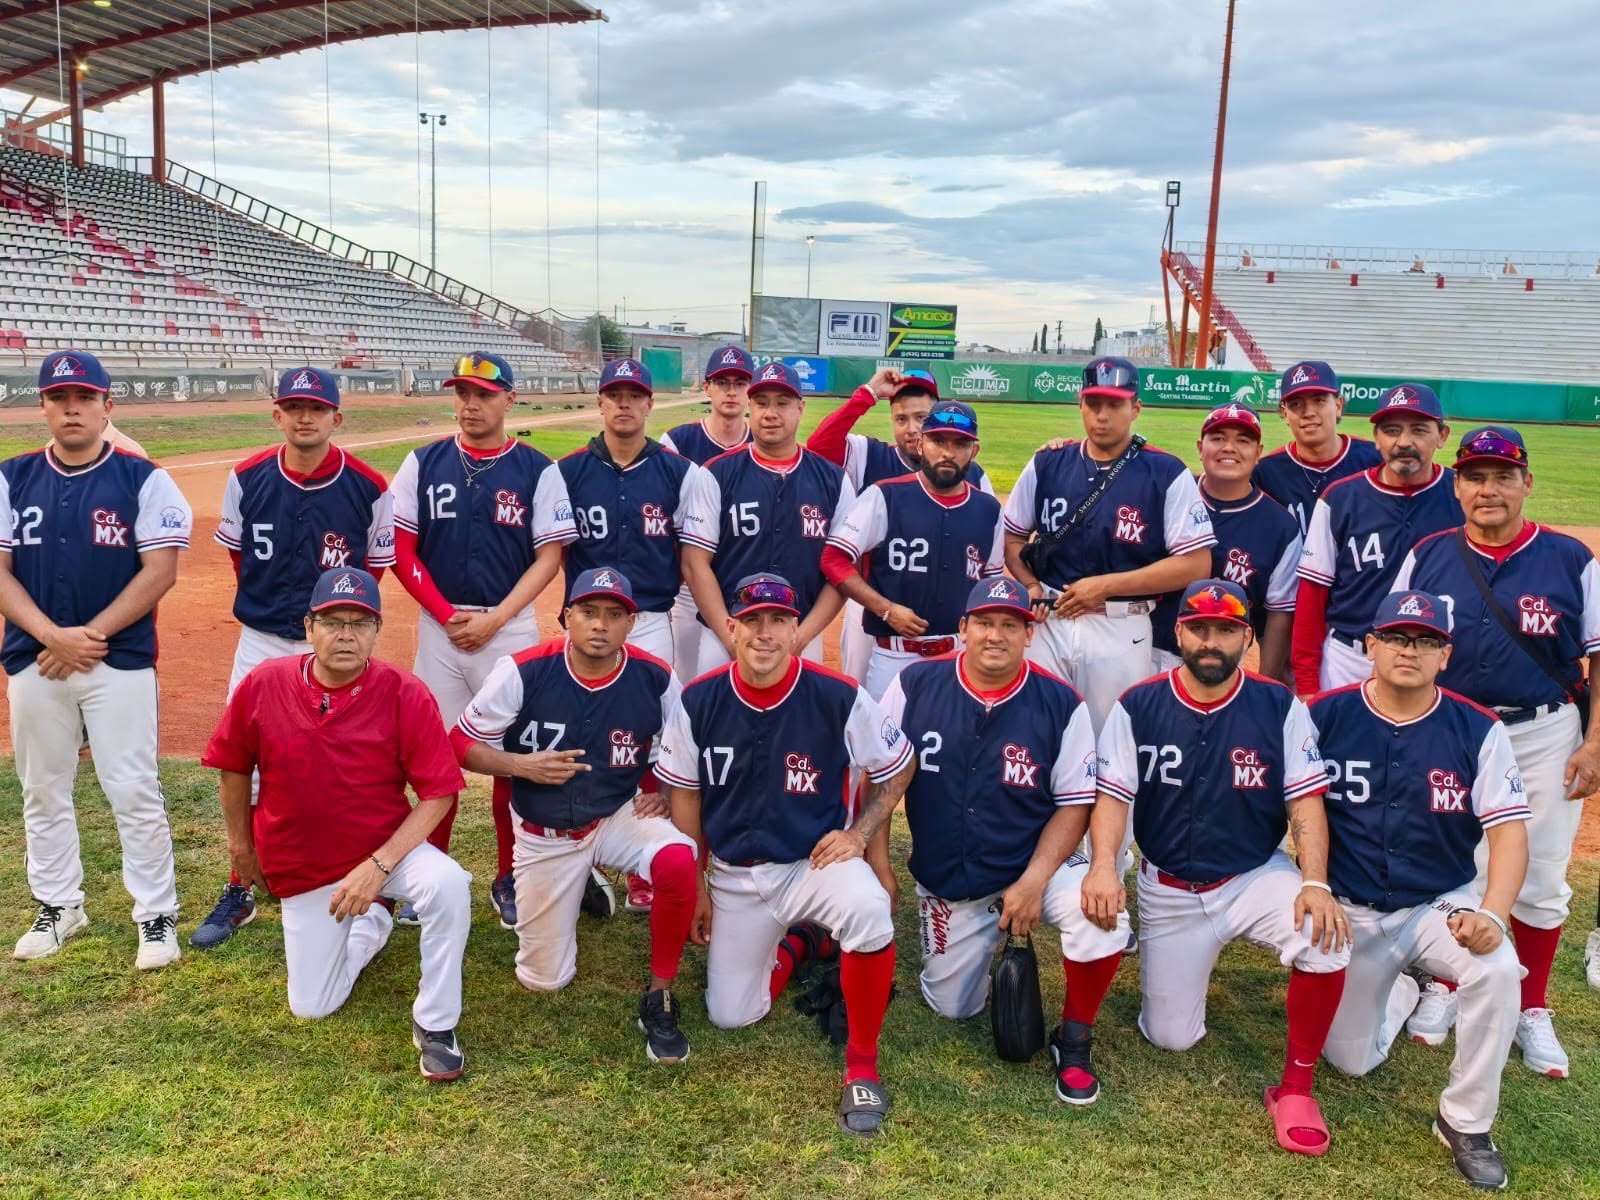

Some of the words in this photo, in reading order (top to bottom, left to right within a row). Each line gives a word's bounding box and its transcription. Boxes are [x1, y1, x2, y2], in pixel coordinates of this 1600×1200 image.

[964, 379, 1006, 390] CIMA
[1056, 382, 1083, 393] CAM
[1144, 373, 1172, 391] San
[426, 483, 457, 519] 12
[1078, 490, 1099, 513] SWOOSH
[496, 504, 525, 526] MX
[577, 505, 608, 539] 89
[643, 517, 668, 536] MX
[729, 501, 760, 537] 15
[802, 518, 827, 537] MX
[1041, 497, 1067, 532] 42
[95, 524, 128, 547] MX
[252, 524, 273, 561] 5
[1115, 520, 1145, 542] MX
[321, 548, 350, 568] MX
[888, 538, 929, 572] 62
[1348, 533, 1385, 572] 14
[965, 558, 982, 577] MX
[1223, 560, 1255, 586] MX
[1521, 611, 1561, 637] MX
[519, 721, 566, 752] 47
[610, 745, 640, 767] MX
[920, 731, 943, 773] 2
[703, 746, 734, 786] 17
[1003, 761, 1040, 788] MX
[1138, 745, 1182, 786] 72
[1233, 765, 1268, 788] MX
[787, 769, 820, 794] MX
[1326, 761, 1371, 803] 25
[1430, 786, 1468, 812] MX
